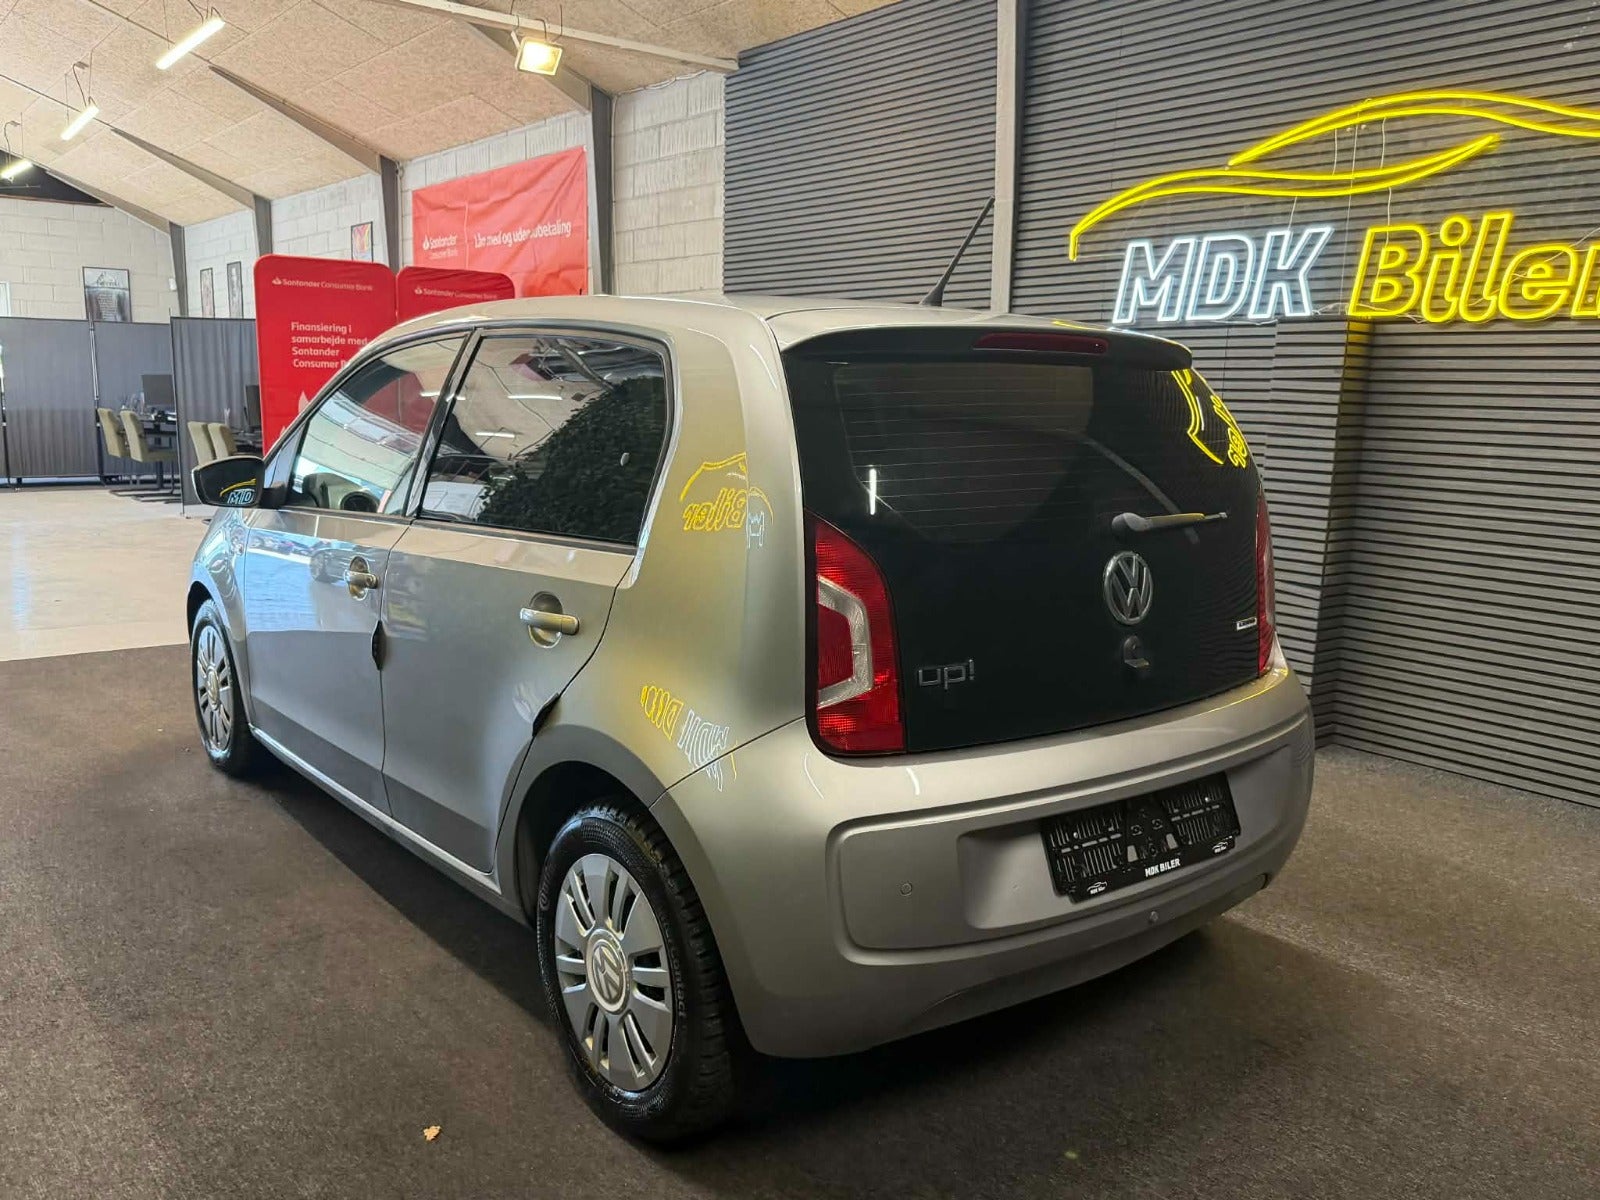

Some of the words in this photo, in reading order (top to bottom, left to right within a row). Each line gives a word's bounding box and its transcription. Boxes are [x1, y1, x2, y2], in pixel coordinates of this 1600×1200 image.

[1111, 226, 1335, 325] MDK
[282, 278, 320, 288] Santander
[291, 322, 347, 334] Finansiering
[291, 335, 346, 346] samarbejde
[292, 346, 339, 356] Santander
[293, 358, 339, 368] Consumer
[918, 659, 974, 690] up!
